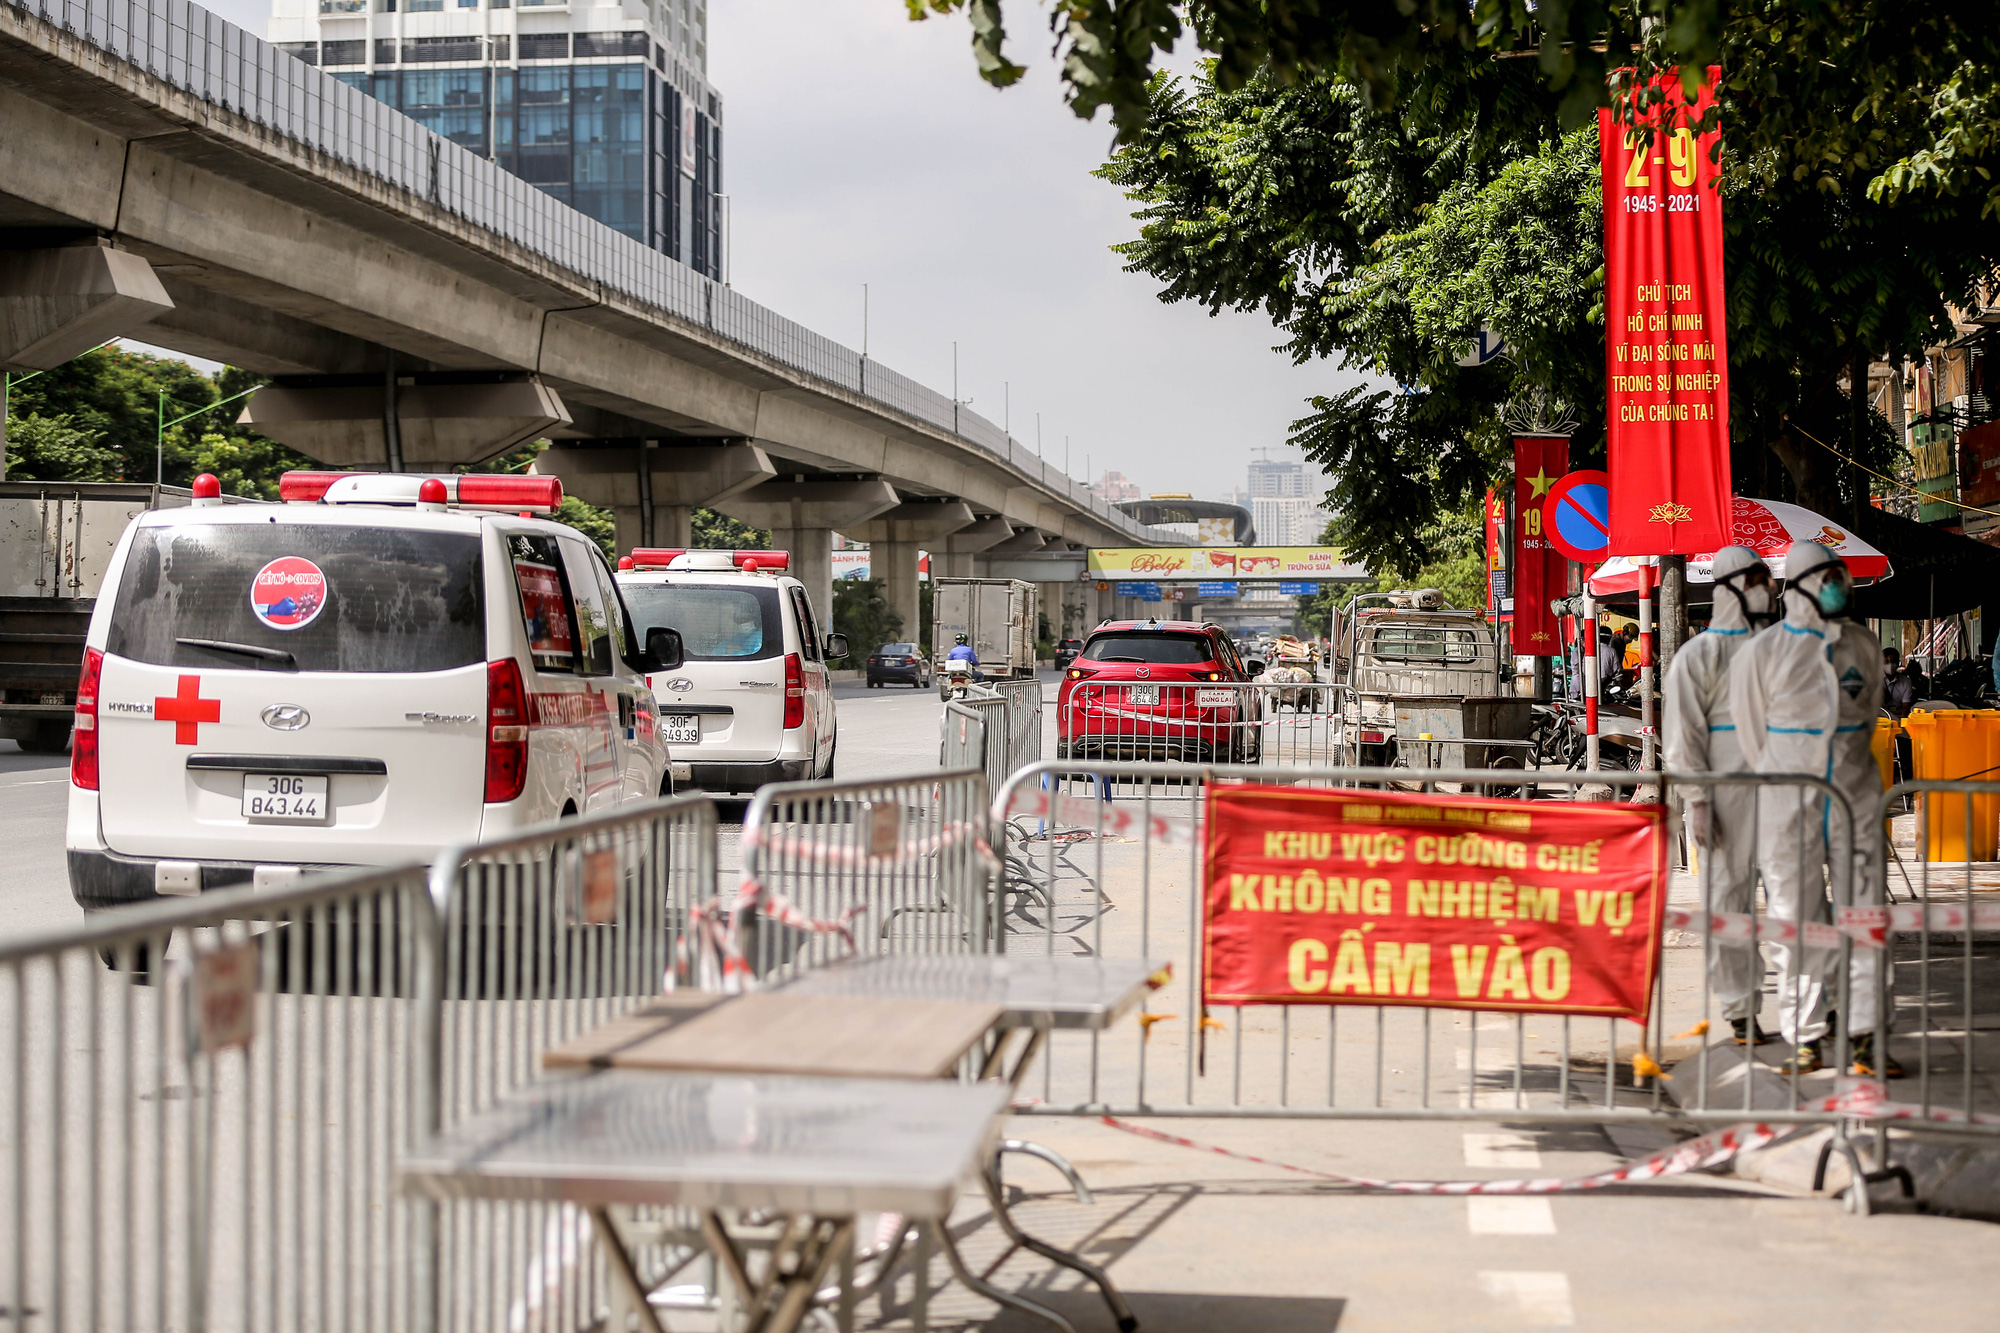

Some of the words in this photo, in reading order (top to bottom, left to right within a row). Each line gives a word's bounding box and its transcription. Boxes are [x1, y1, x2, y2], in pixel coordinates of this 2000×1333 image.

[1623, 127, 1697, 187] 2-9
[1624, 195, 1656, 213] 1945
[1668, 194, 1700, 212] 2021
[1637, 279, 1661, 302] CHỦ
[1665, 284, 1691, 304] TỊCH
[1627, 308, 1644, 332] HỒ
[1648, 310, 1668, 331] CHÍ
[1672, 314, 1703, 331] MINH
[1616, 342, 1628, 362] VĨ
[1632, 345, 1653, 365] ĐẠI
[1657, 338, 1688, 361] SỐNG
[1693, 340, 1715, 360] MÃI
[1612, 374, 1652, 392] TRONG
[1657, 372, 1672, 394] SỰ
[1676, 370, 1721, 393] NGHIỆP
[1621, 399, 1645, 422] CỦA
[1649, 400, 1688, 421] CHÚNG
[1523, 540, 1539, 549] 1945
[1131, 553, 1185, 576] Belgi
[669, 716, 689, 728] 30F
[268, 776, 303, 795] 30G
[251, 797, 317, 816] 843.44
[1263, 830, 1332, 860] KHU
[1341, 832, 1405, 868] VỰC
[1416, 833, 1527, 869] CƯỠNG
[1536, 838, 1603, 875] CHẾ
[1229, 869, 1393, 916] KHÔNG
[1406, 876, 1560, 927] NHIỆM
[1575, 888, 1635, 938] VỤ
[1287, 922, 1432, 997] CẤM
[1449, 933, 1572, 1002] VÀO
